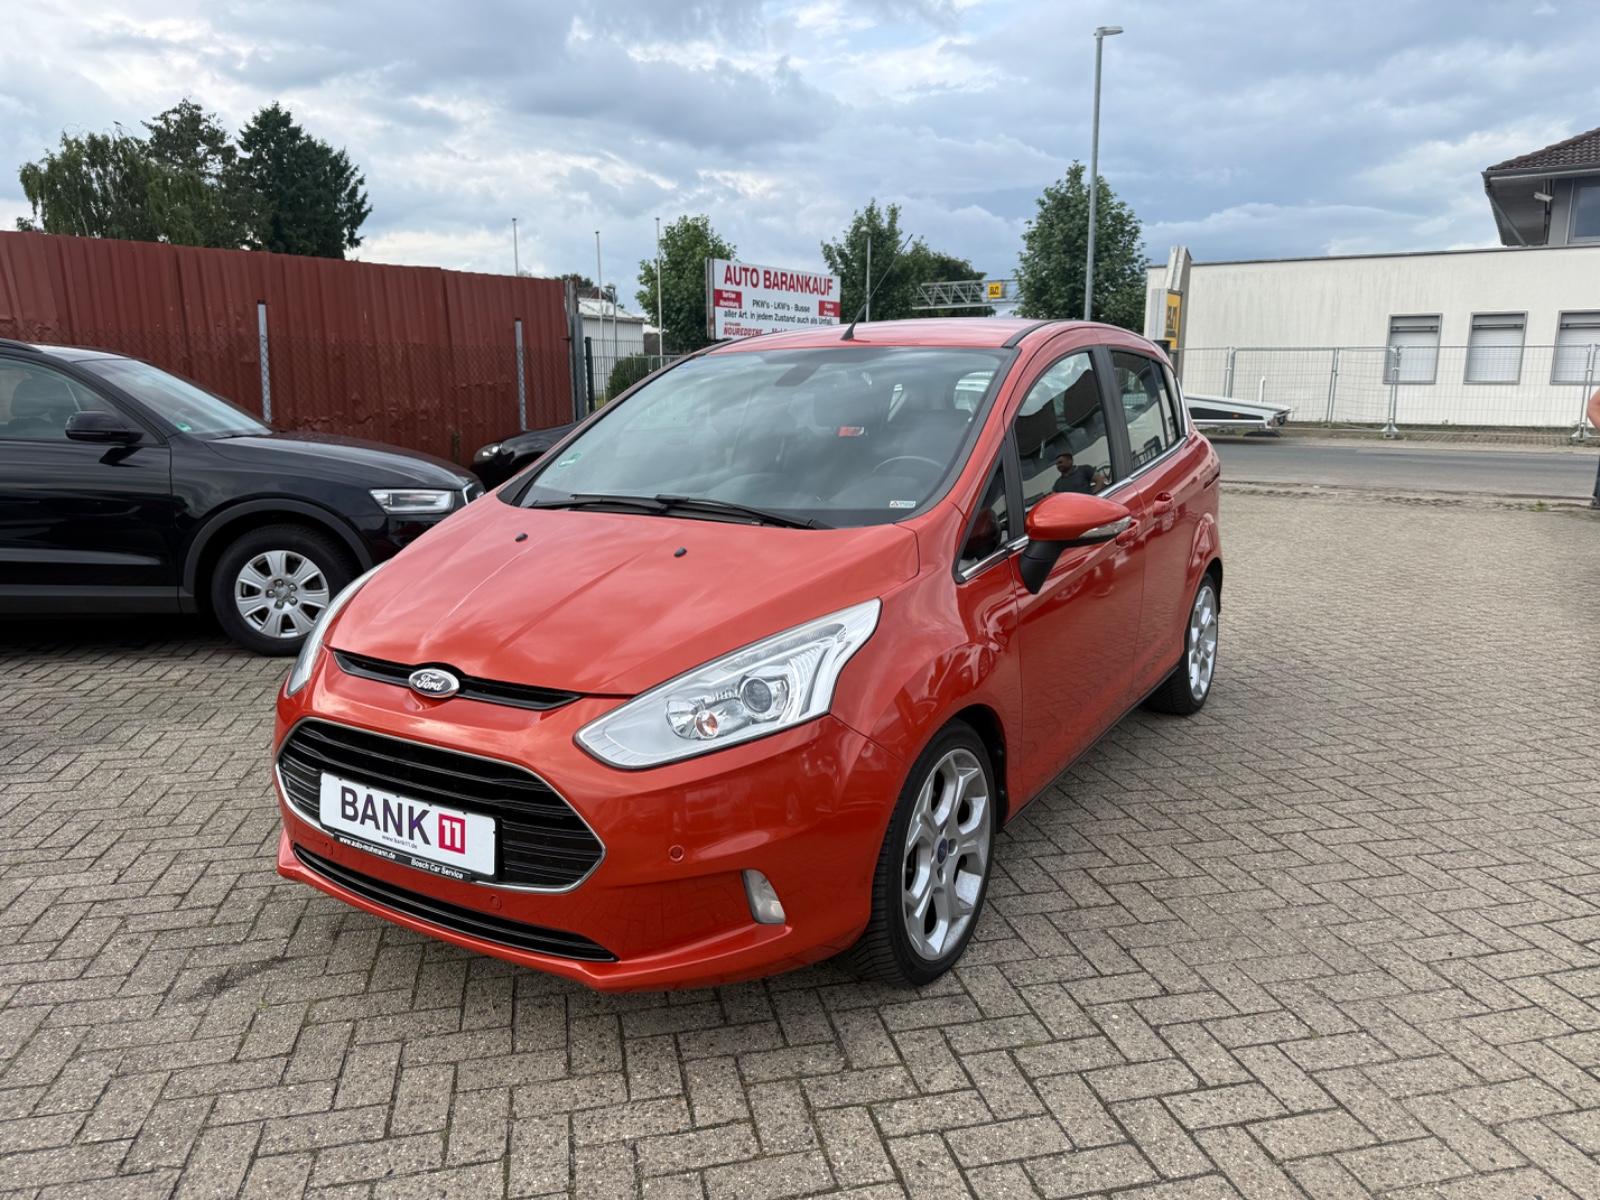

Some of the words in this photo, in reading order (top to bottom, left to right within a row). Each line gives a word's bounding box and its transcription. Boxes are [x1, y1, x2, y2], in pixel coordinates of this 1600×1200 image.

[724, 264, 760, 288] AUTO
[763, 270, 833, 296] BARANKAUF
[752, 299, 770, 309] PKW's
[774, 301, 790, 311] LKW's
[794, 303, 811, 313] Busse
[723, 309, 737, 319] aller
[756, 312, 774, 322] jedem
[774, 313, 796, 323] Zustand
[796, 316, 809, 324] auch
[810, 317, 818, 325] als
[416, 672, 445, 691] Ford
[341, 785, 431, 846] BANK
[442, 819, 461, 849] 11
[411, 857, 430, 870] Bosch
[430, 864, 441, 873] Car
[441, 866, 464, 880] Service
